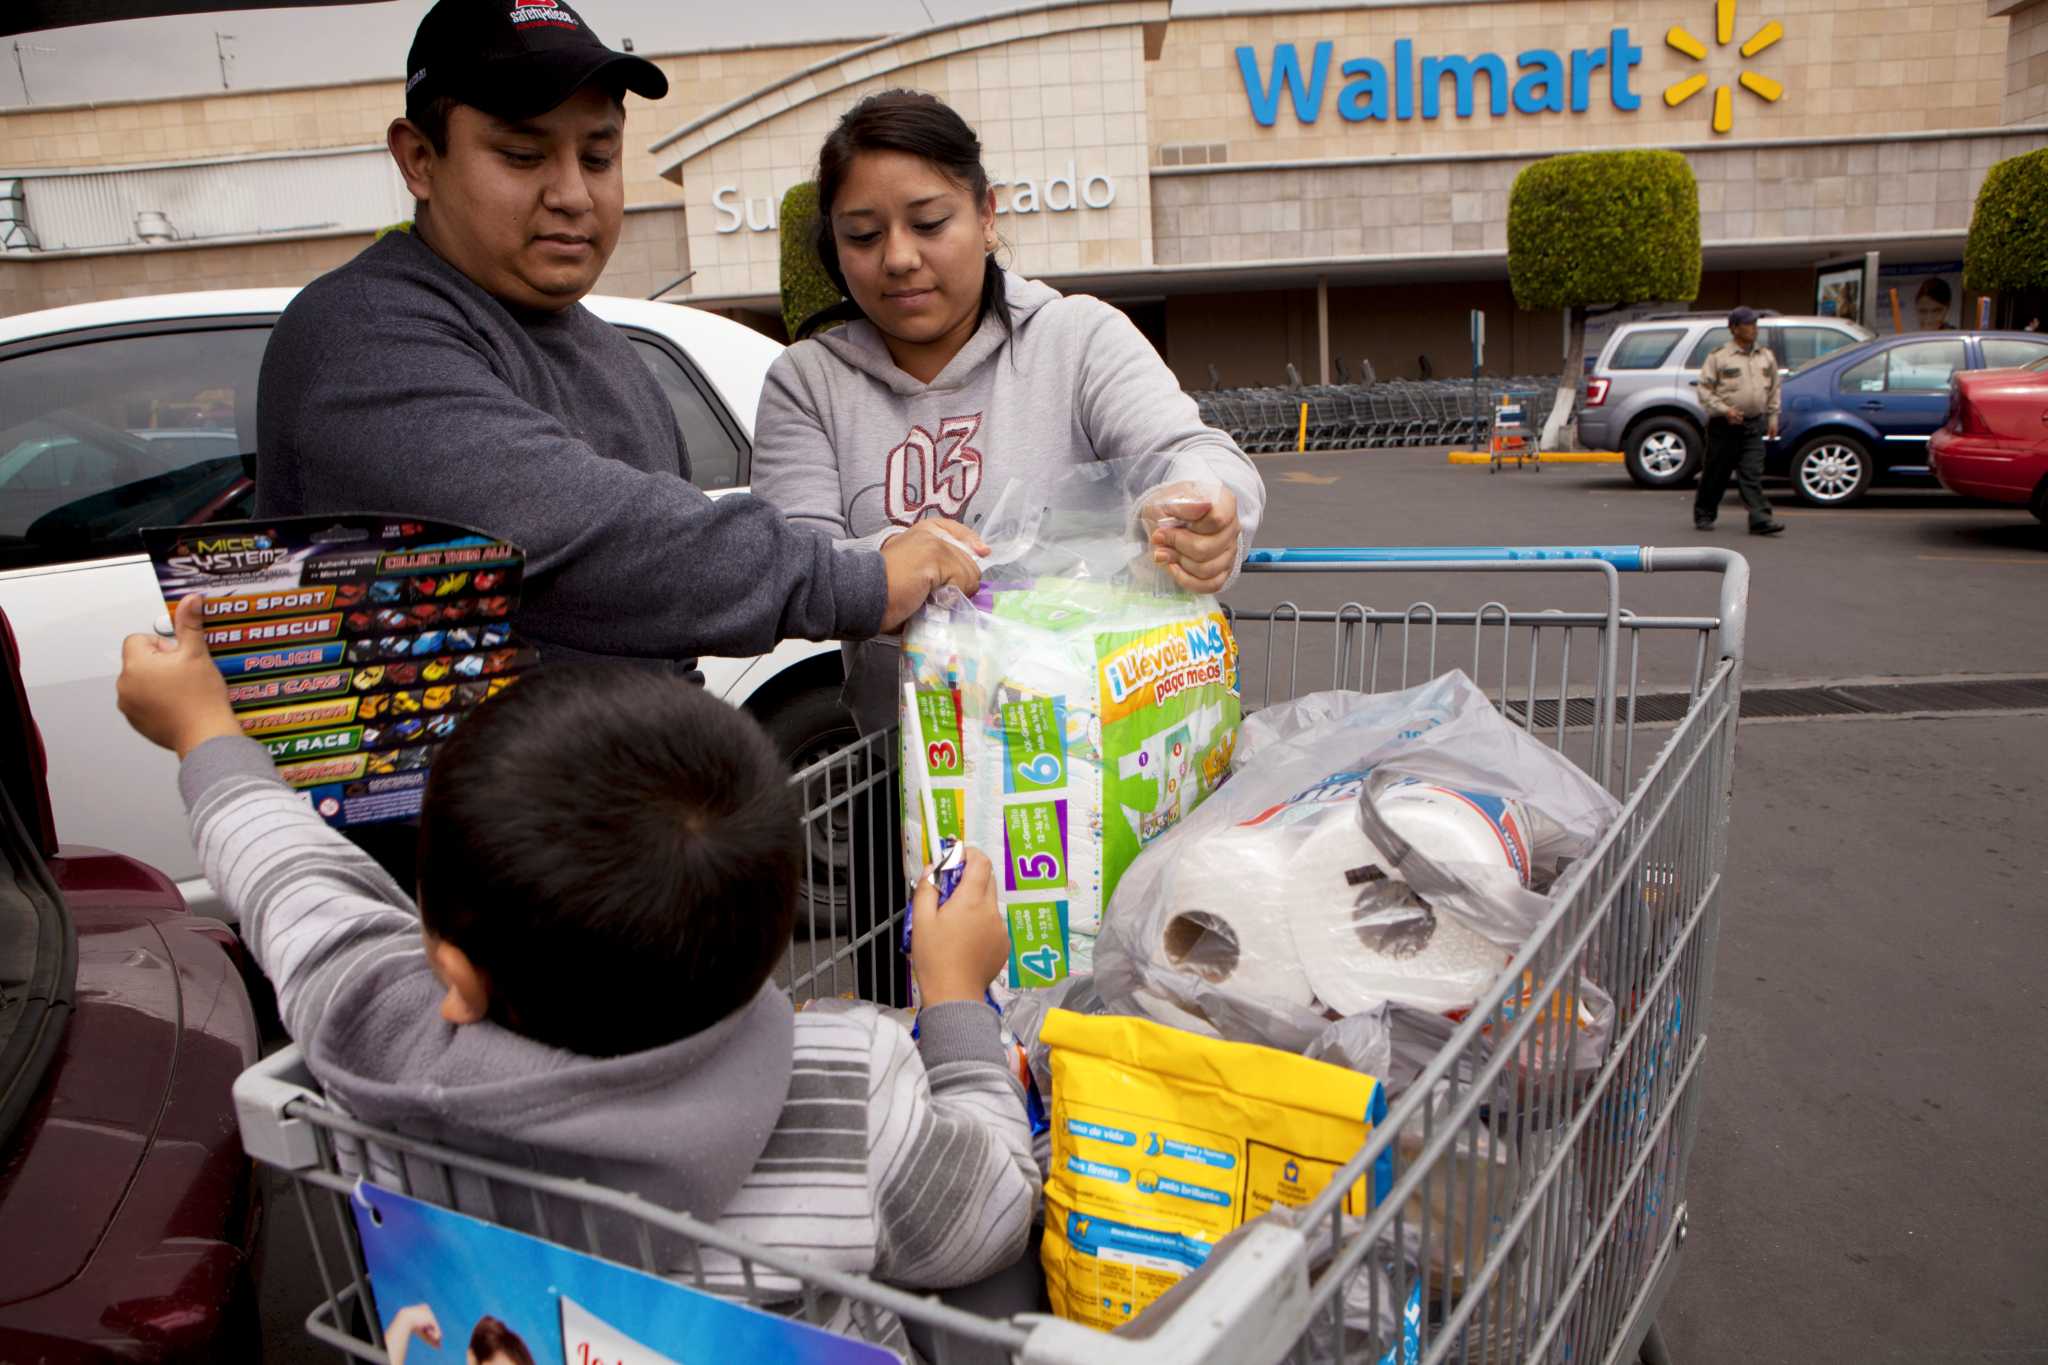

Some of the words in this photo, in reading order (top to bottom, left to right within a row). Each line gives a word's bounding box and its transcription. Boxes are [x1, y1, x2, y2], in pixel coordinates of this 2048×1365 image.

[1235, 28, 1643, 127] Walmart
[203, 598, 249, 616] URO
[255, 591, 326, 611] SPORT
[204, 629, 242, 645] IRE
[248, 619, 332, 640] RESCUE
[244, 648, 324, 671] POLICE
[227, 682, 279, 702] SCLE
[282, 674, 342, 695] CARS
[241, 703, 349, 730] STRUCTION
[295, 732, 351, 753] RACE
[928, 739, 957, 769] 3
[1017, 752, 1062, 785] 6
[1018, 853, 1060, 881] 5
[1020, 944, 1061, 982] 4
